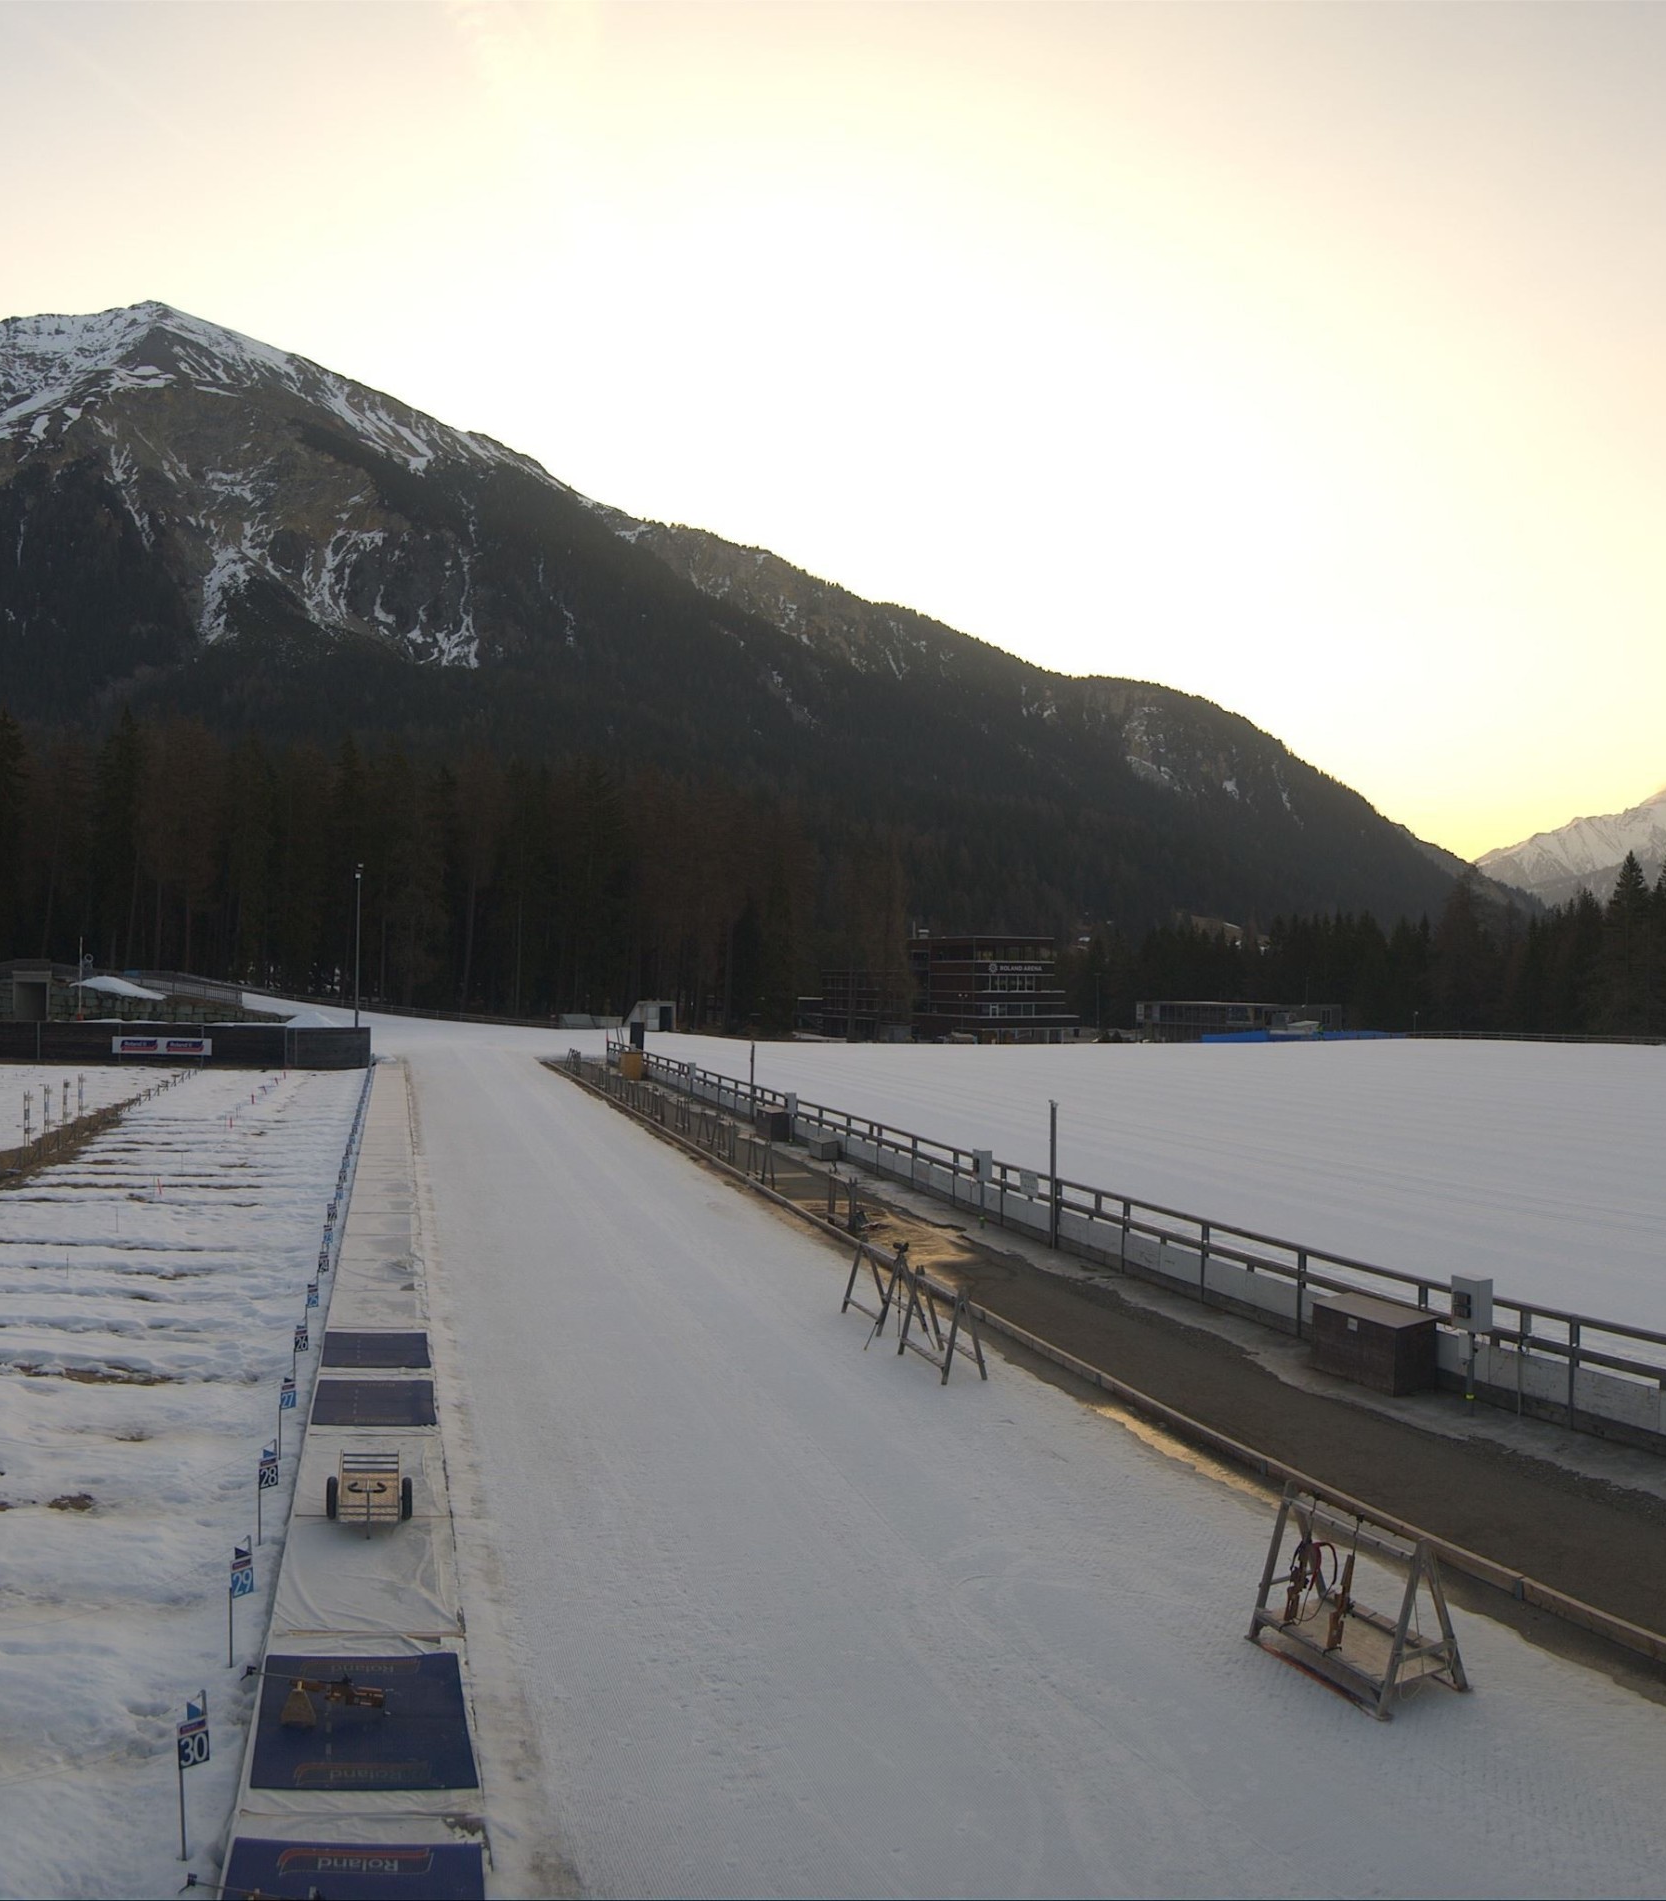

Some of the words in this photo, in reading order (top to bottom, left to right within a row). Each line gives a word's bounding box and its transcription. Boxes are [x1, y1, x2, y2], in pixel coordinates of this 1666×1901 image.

[295, 1335, 307, 1351] 26
[281, 1390, 294, 1408] 27
[260, 1466, 278, 1488] 28
[233, 1569, 253, 1598] 29
[180, 1732, 208, 1767] 30
[317, 1856, 399, 1872] Roland
